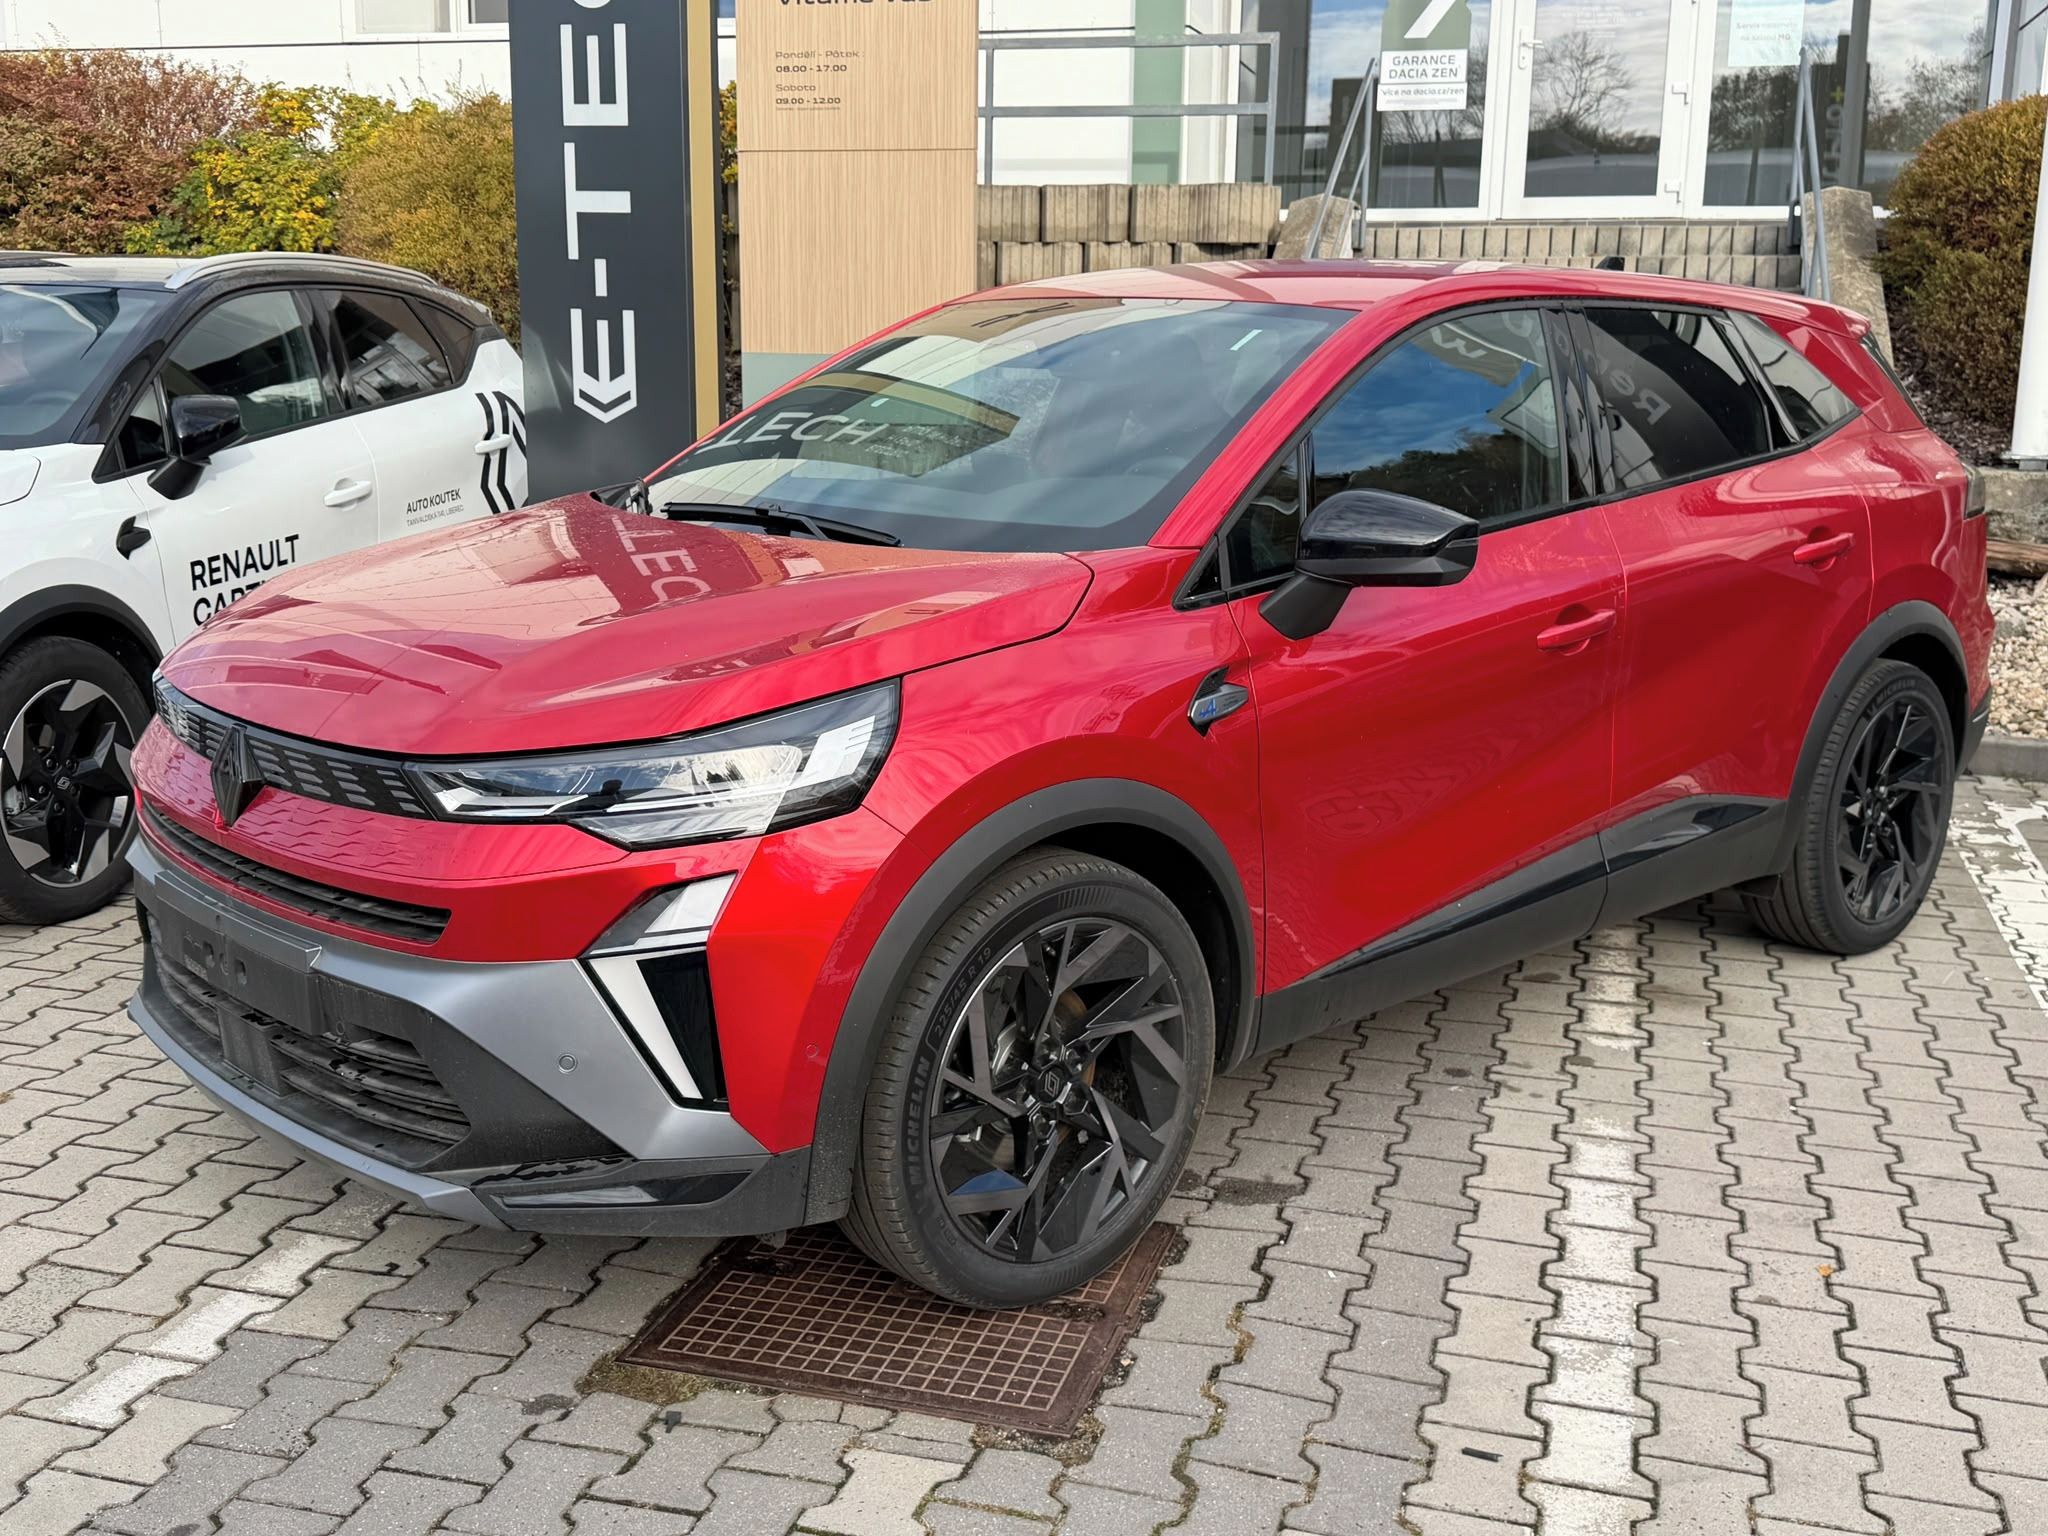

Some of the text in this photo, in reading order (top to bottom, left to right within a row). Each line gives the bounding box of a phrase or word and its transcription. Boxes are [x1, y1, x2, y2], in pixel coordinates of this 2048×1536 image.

[775, 65, 807, 73] 08.00
[816, 64, 848, 73] 17.00
[1392, 55, 1456, 66] GARANCE
[1389, 67, 1458, 79] DACIA ZEN
[775, 97, 805, 105] 09.00
[813, 97, 841, 105] 12.00
[560, 0, 638, 424] E-TE
[406, 488, 461, 515] AUTO KOUTEK
[190, 534, 299, 591] RENAULT
[193, 580, 265, 627] CAP
[979, 947, 992, 965] 19
[906, 1055, 931, 1186] MICHELIN
